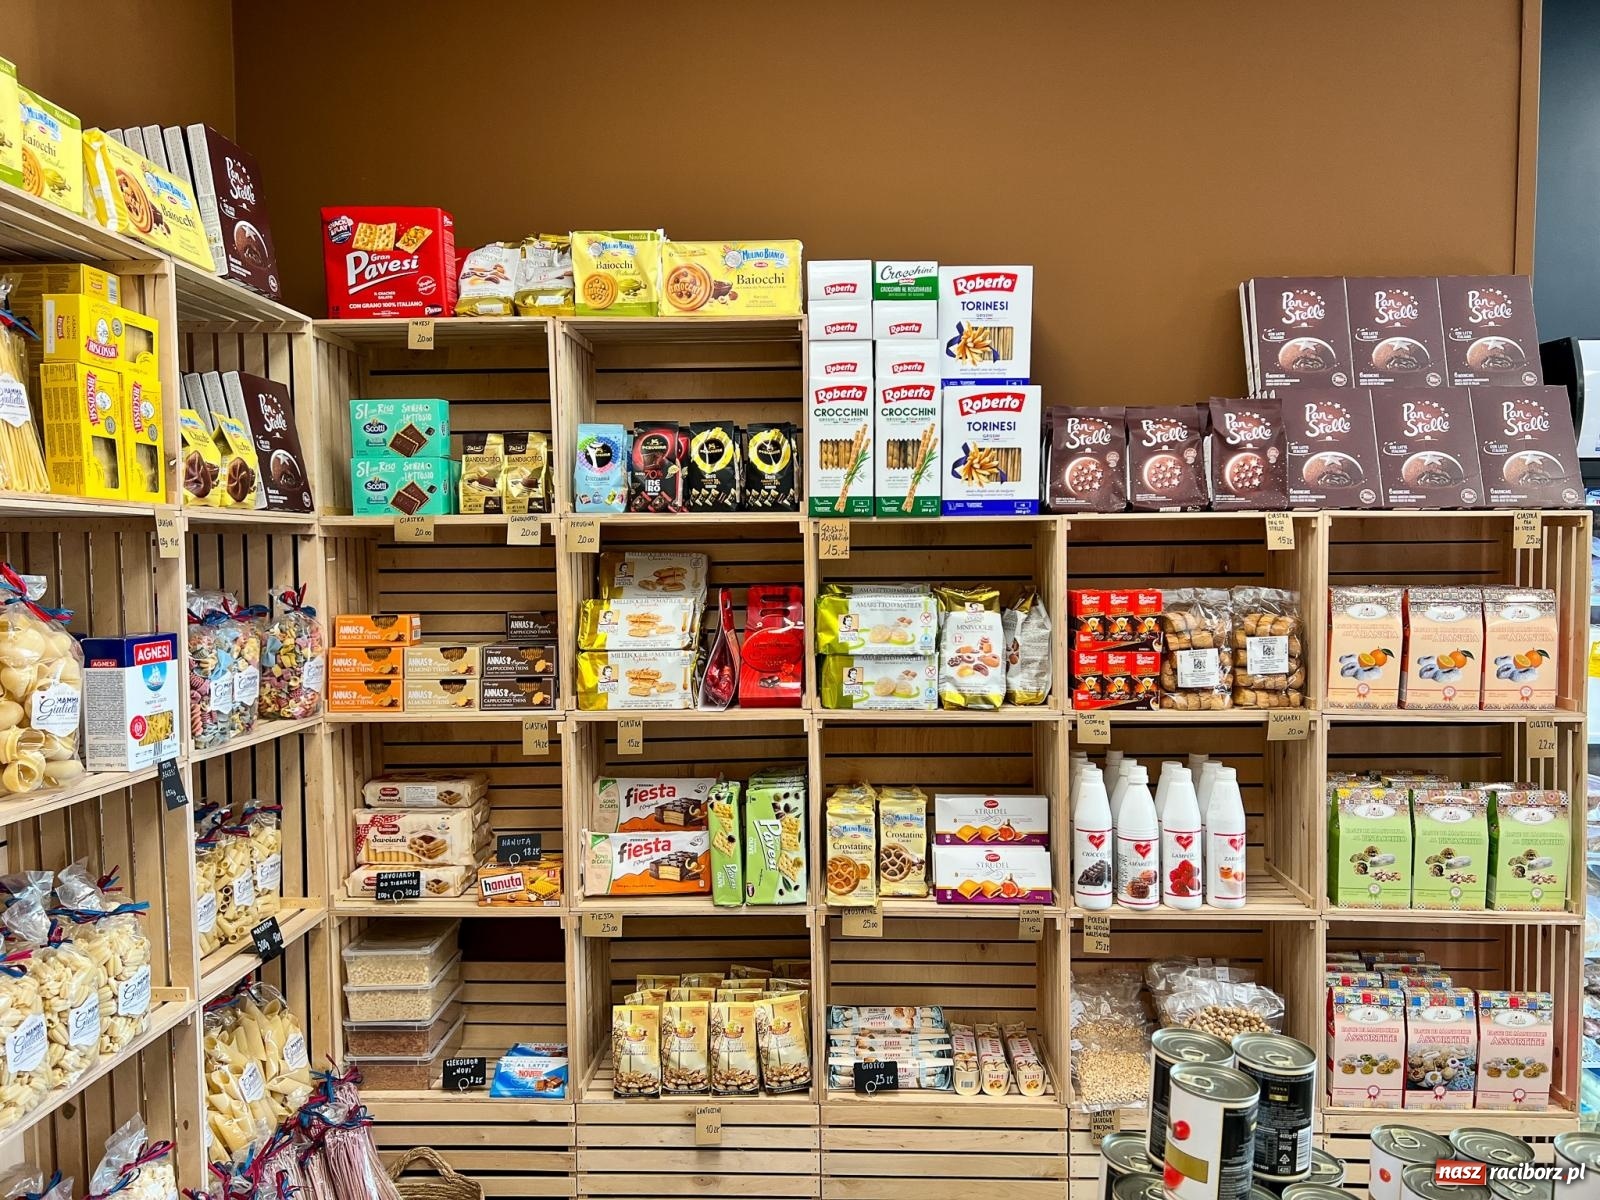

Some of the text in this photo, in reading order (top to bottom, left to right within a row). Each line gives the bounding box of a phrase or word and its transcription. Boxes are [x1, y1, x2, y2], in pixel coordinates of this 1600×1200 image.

[230, 178, 256, 205] Stelle
[370, 253, 391, 261] Gran
[742, 248, 785, 261] MULINO BIANCO
[345, 250, 419, 287] Pavesi
[596, 260, 633, 270] Baiocchi
[736, 272, 786, 285] Baiocchi
[957, 274, 1012, 293] Roberto
[826, 285, 856, 294] Roberto
[960, 301, 1009, 312] TORINESI
[1281, 291, 1304, 310] Pan
[1374, 291, 1397, 309] Pan
[1467, 290, 1491, 309] Pan
[1281, 306, 1326, 325] Stelle
[1374, 305, 1419, 325] Stelle
[1468, 304, 1513, 324] Stelle
[826, 323, 856, 334] Roberto
[890, 323, 921, 334] Roberto
[88, 341, 117, 359] RISCOSSA
[826, 363, 857, 374] Roberto
[893, 363, 924, 373] Roberto
[86, 374, 98, 423] RISCOSSA
[817, 387, 863, 403] Roberto
[884, 387, 931, 403] Roberto
[132, 384, 143, 432] RISCOSSA
[813, 407, 869, 417] CROCCHINI
[881, 407, 936, 417] CROCCHINI
[962, 394, 1021, 414] Roberto
[1402, 402, 1426, 422] Pan
[1502, 401, 1525, 421] Pan
[1304, 402, 1328, 423] Pan
[264, 411, 288, 433] Stelle
[966, 421, 1017, 432] TORINESI
[1066, 417, 1090, 434] Pan
[1141, 419, 1166, 433] Pan
[1224, 412, 1249, 430] Pan
[1305, 419, 1352, 438] Stelle
[1403, 418, 1451, 438] Stelle
[1503, 417, 1551, 437] Stelle
[1065, 429, 1112, 450] Stelle
[1142, 427, 1189, 448] Stelle
[1225, 425, 1273, 446] Stelle
[339, 625, 359, 635] ANNAS
[510, 620, 530, 629] ANNAS
[137, 644, 170, 662] AGNESI
[486, 656, 507, 665] ANNAS
[332, 658, 352, 667] ANNAS
[407, 657, 428, 667] ANNAS
[332, 690, 352, 699] ANNAS
[407, 690, 428, 699] ANNAS
[483, 689, 504, 697] ANNAS
[619, 720, 641, 728] CIASTKA
[624, 783, 676, 808] fiesta
[371, 834, 407, 844] Savoiardi
[885, 830, 924, 839] Crostatine
[617, 837, 671, 863] fiesta
[753, 819, 780, 872] Pavesi
[832, 842, 872, 851] Crostatine
[484, 875, 522, 893] hanuta
[1344, 1033, 1398, 1042] ASSORTITE
[1416, 1035, 1470, 1045] ASSORTITE
[1491, 1037, 1545, 1047] ASSORTITE
